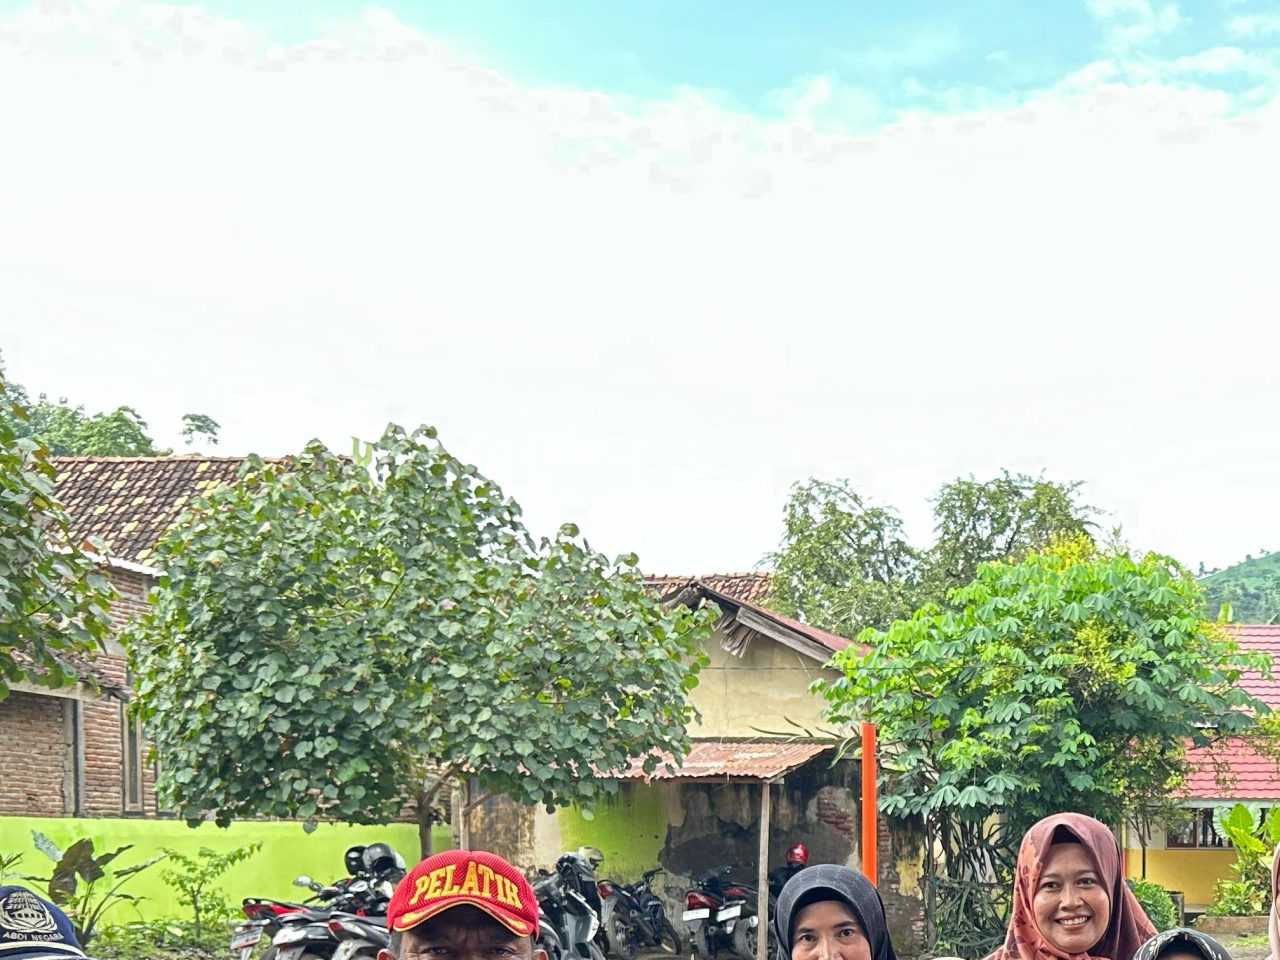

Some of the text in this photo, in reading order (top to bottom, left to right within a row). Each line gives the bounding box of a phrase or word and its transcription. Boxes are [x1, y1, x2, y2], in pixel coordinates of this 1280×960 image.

[409, 861, 523, 910] PELATIH
[3, 932, 64, 941] ABDI NEGARA
